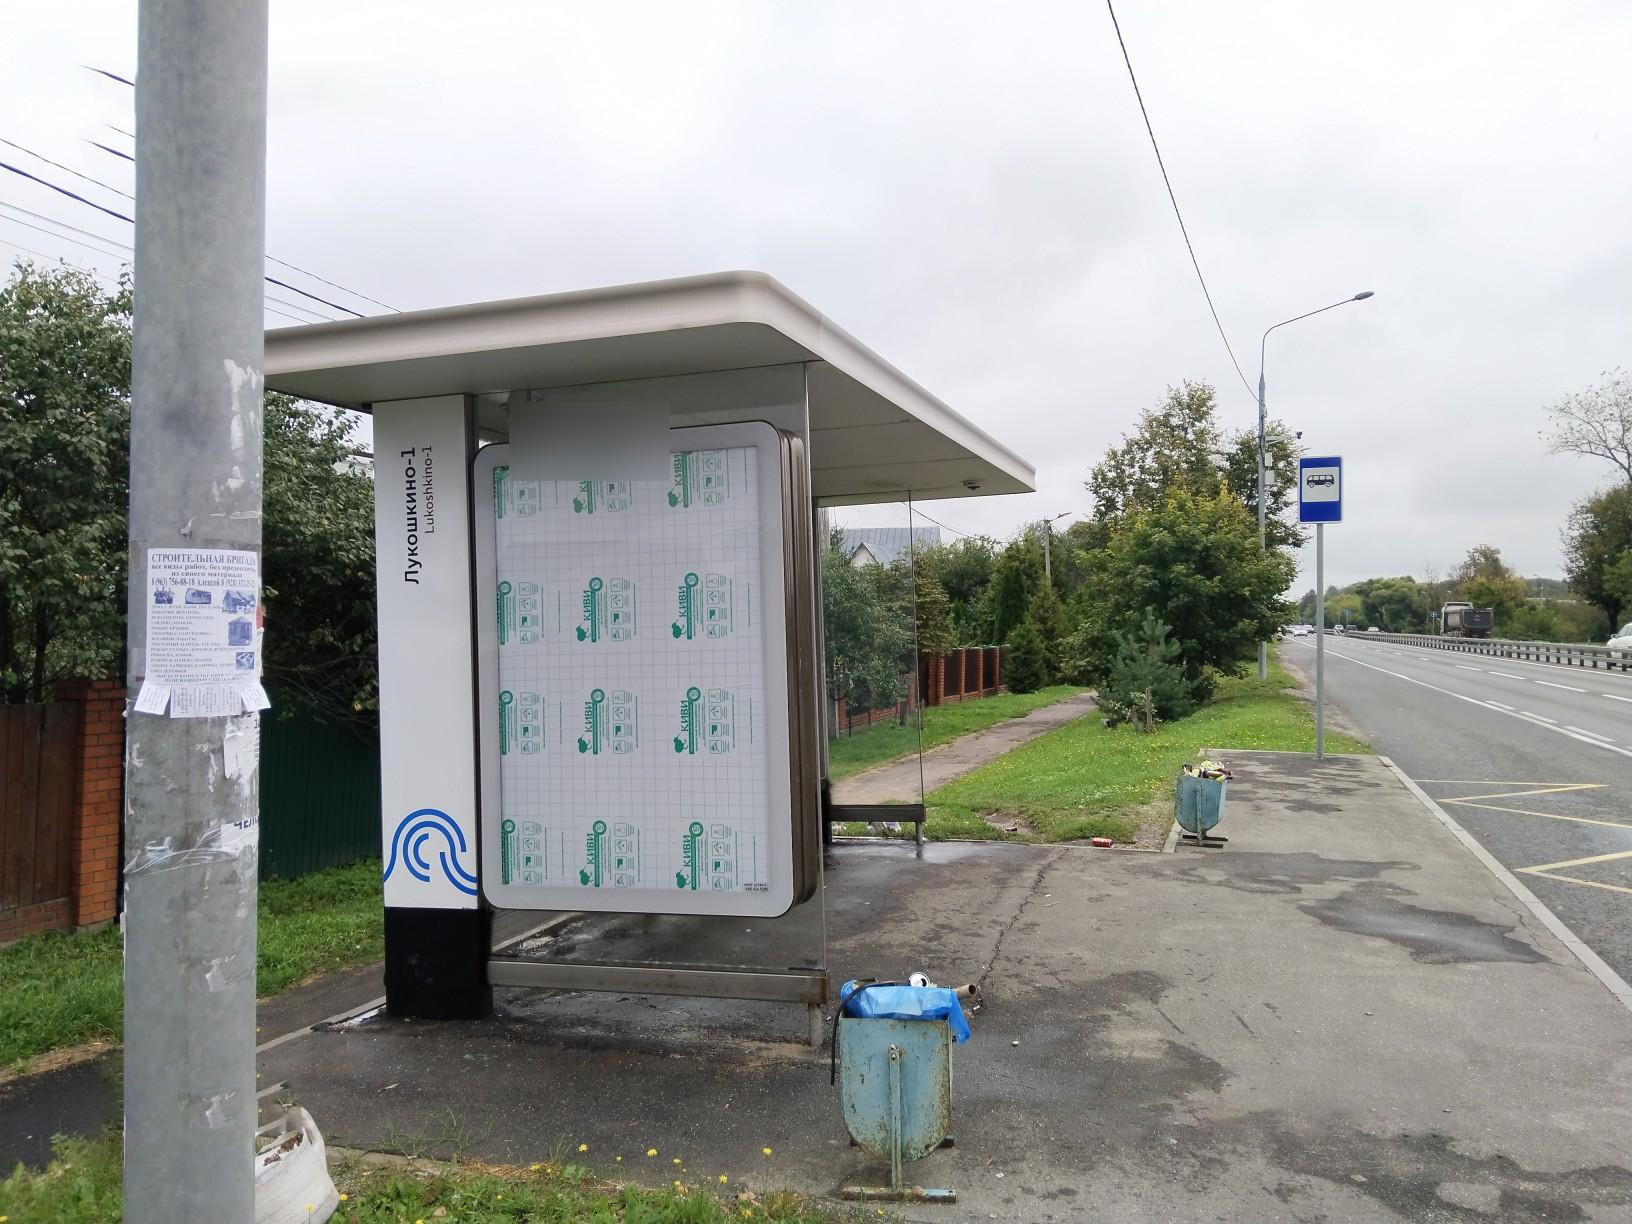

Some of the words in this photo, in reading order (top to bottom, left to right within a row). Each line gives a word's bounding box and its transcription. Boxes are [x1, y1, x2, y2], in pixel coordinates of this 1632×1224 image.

[674, 454, 682, 486] КИВИ
[422, 445, 434, 534] Lukoshkino-1
[400, 447, 422, 585] Лукошкино-1
[152, 553, 224, 564] СТРОИТЕЛЬНАЯ
[226, 555, 256, 566] БРИГАДА
[196, 578, 220, 587] Алексей
[583, 590, 591, 620] КИВИ
[678, 586, 686, 618] КИВИ
[681, 700, 689, 732] КИВИ
[683, 834, 691, 867] КИВИ
